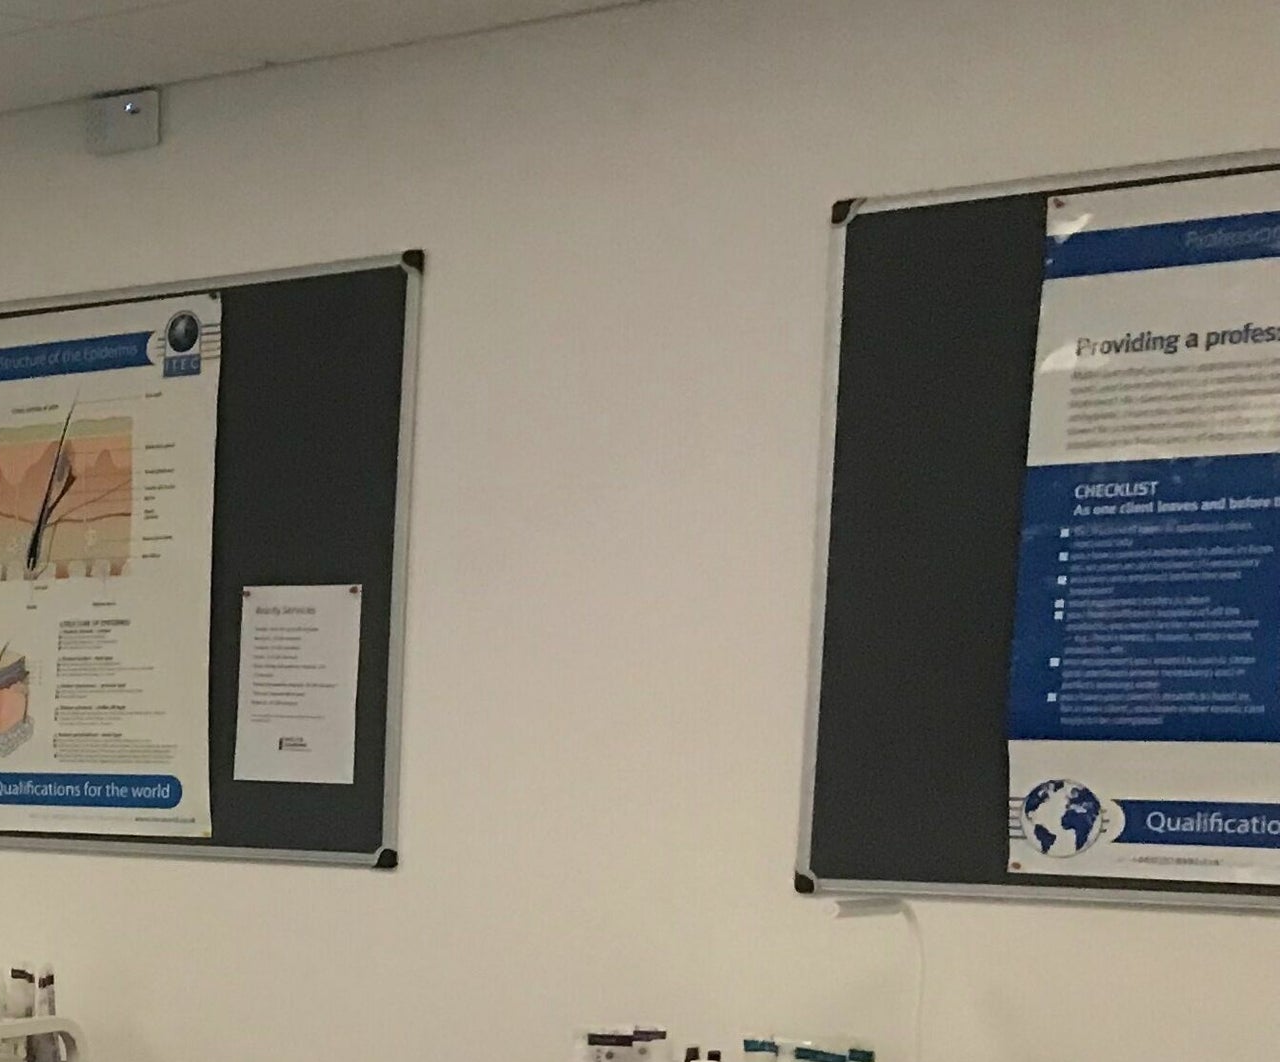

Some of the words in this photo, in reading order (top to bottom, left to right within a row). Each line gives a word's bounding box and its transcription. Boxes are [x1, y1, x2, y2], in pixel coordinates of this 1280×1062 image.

[1076, 332, 1180, 356] Providing
[1185, 332, 1199, 349] a
[1074, 481, 1160, 499] CHECKLIST
[1073, 503, 1091, 516] As
[1119, 501, 1154, 515] client
[1157, 500, 1199, 513] leaves
[1200, 497, 1226, 511] and
[1228, 496, 1271, 510] before
[83, 780, 102, 798] for
[105, 781, 129, 798] the
[131, 783, 171, 799] world
[1146, 811, 1280, 835] Qualificatio
